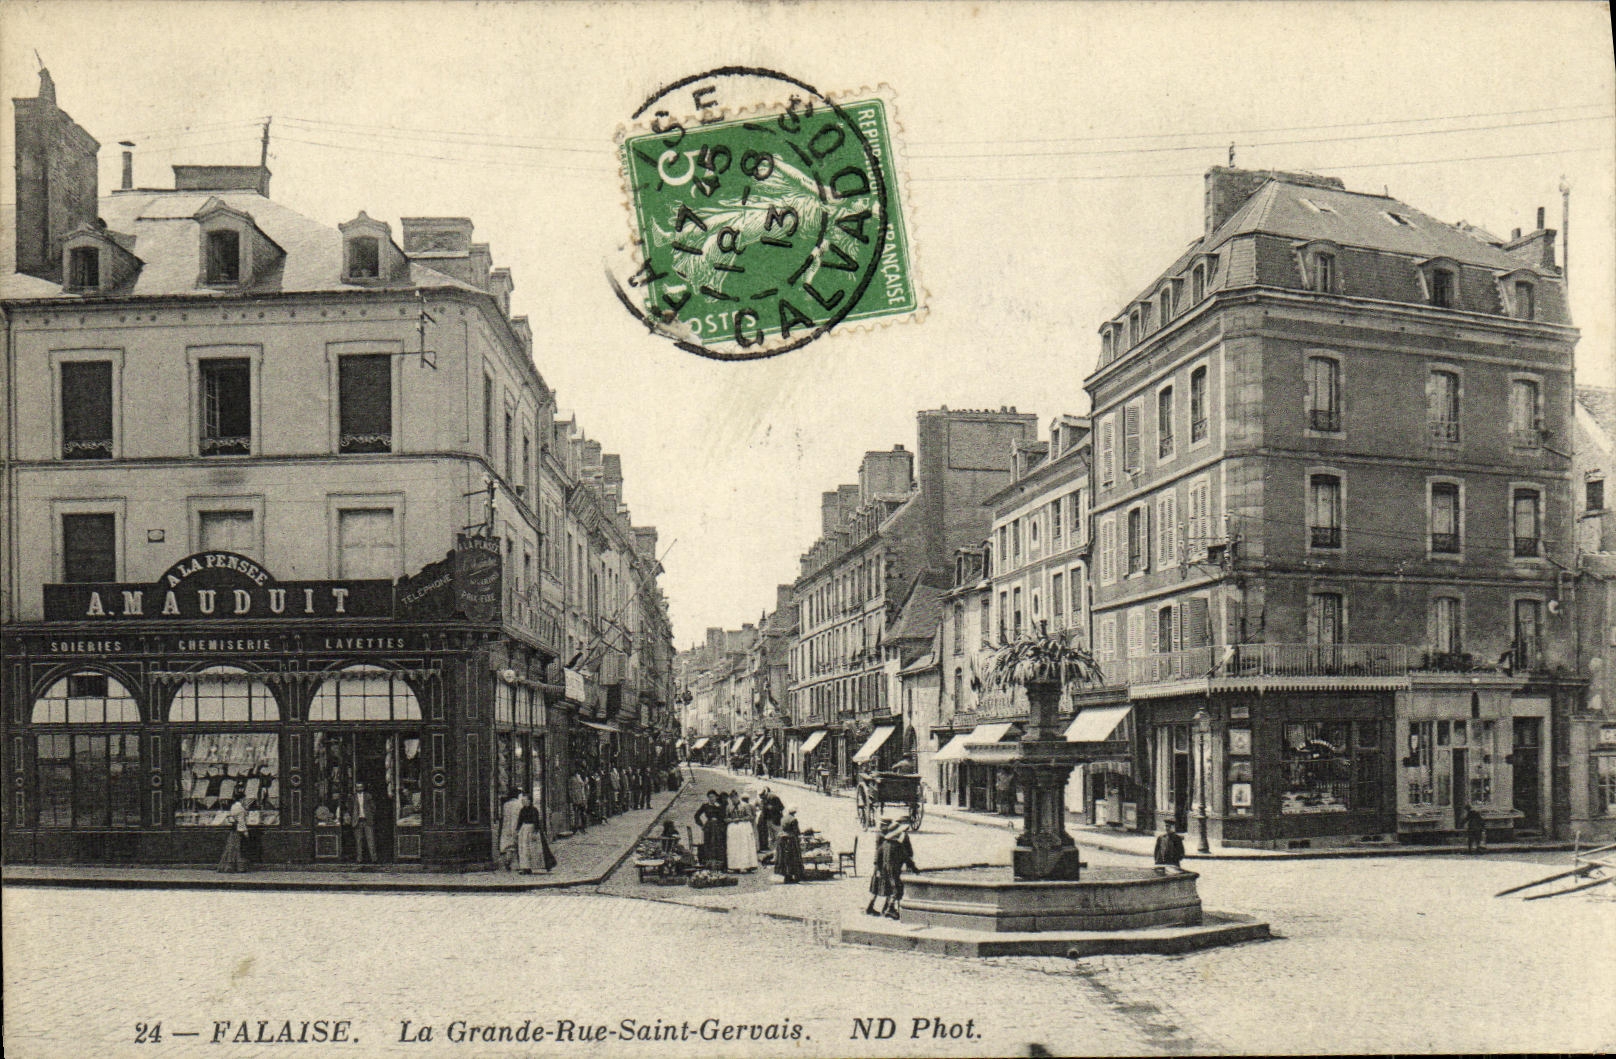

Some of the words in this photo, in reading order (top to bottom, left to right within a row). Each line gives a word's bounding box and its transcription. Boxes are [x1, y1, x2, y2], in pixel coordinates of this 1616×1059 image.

[167, 574, 181, 588] A
[178, 558, 204, 577] LA
[122, 587, 349, 617] MAUDUIT
[50, 640, 122, 653] SOIERIES
[178, 638, 271, 651] CHEMISERIE
[325, 637, 406, 650] LAYETTES
